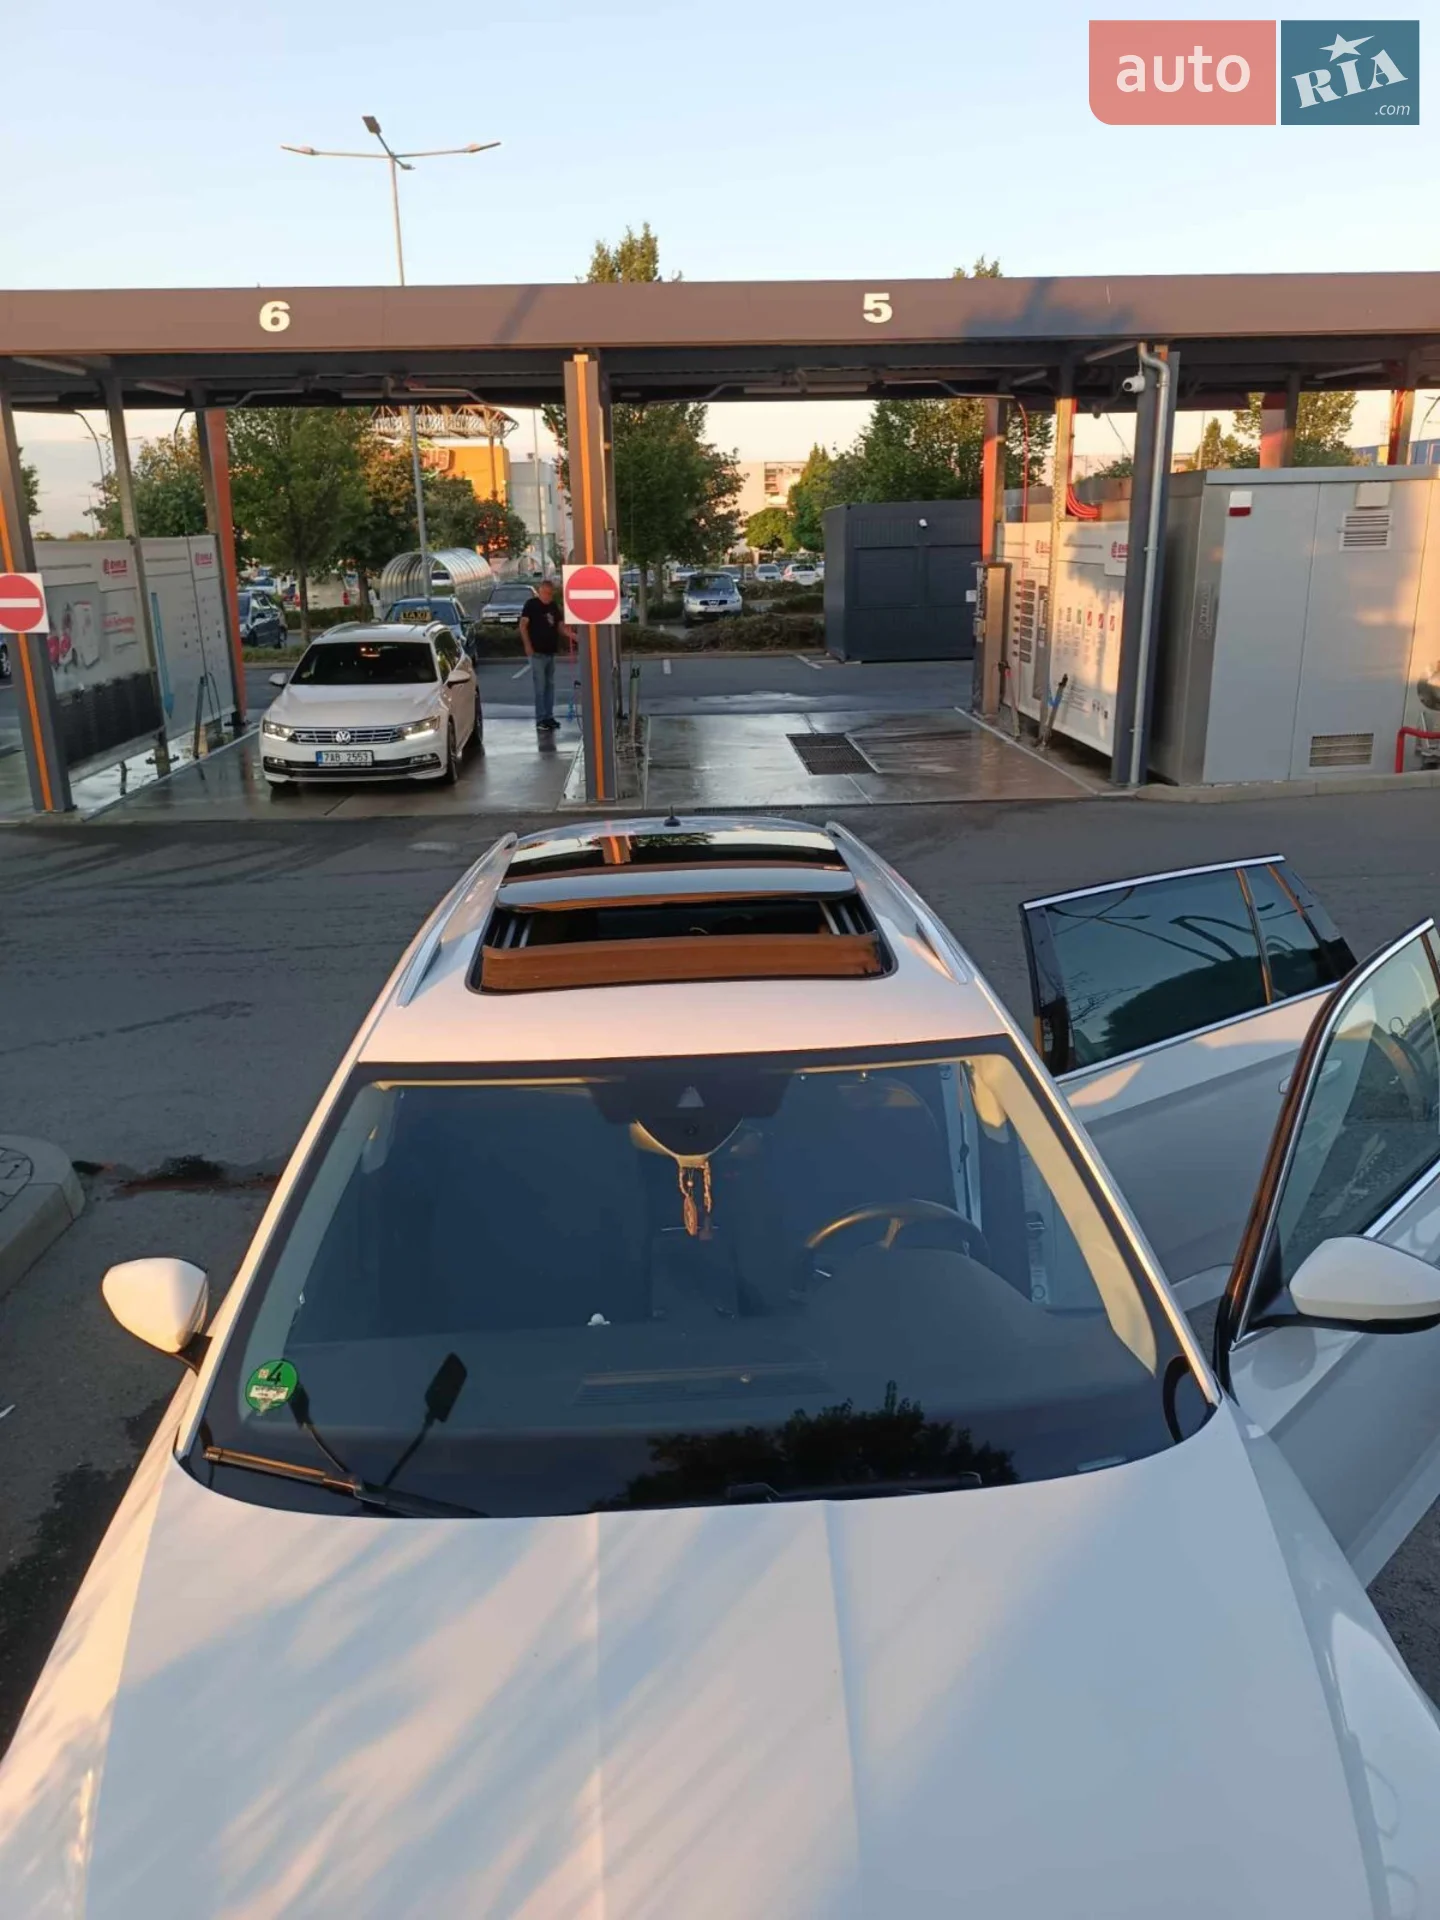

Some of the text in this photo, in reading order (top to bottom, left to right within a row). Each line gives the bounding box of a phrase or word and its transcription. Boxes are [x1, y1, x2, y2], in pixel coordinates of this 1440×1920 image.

[259, 300, 291, 332] 6
[863, 292, 893, 324] 5
[267, 1362, 284, 1385] 4
